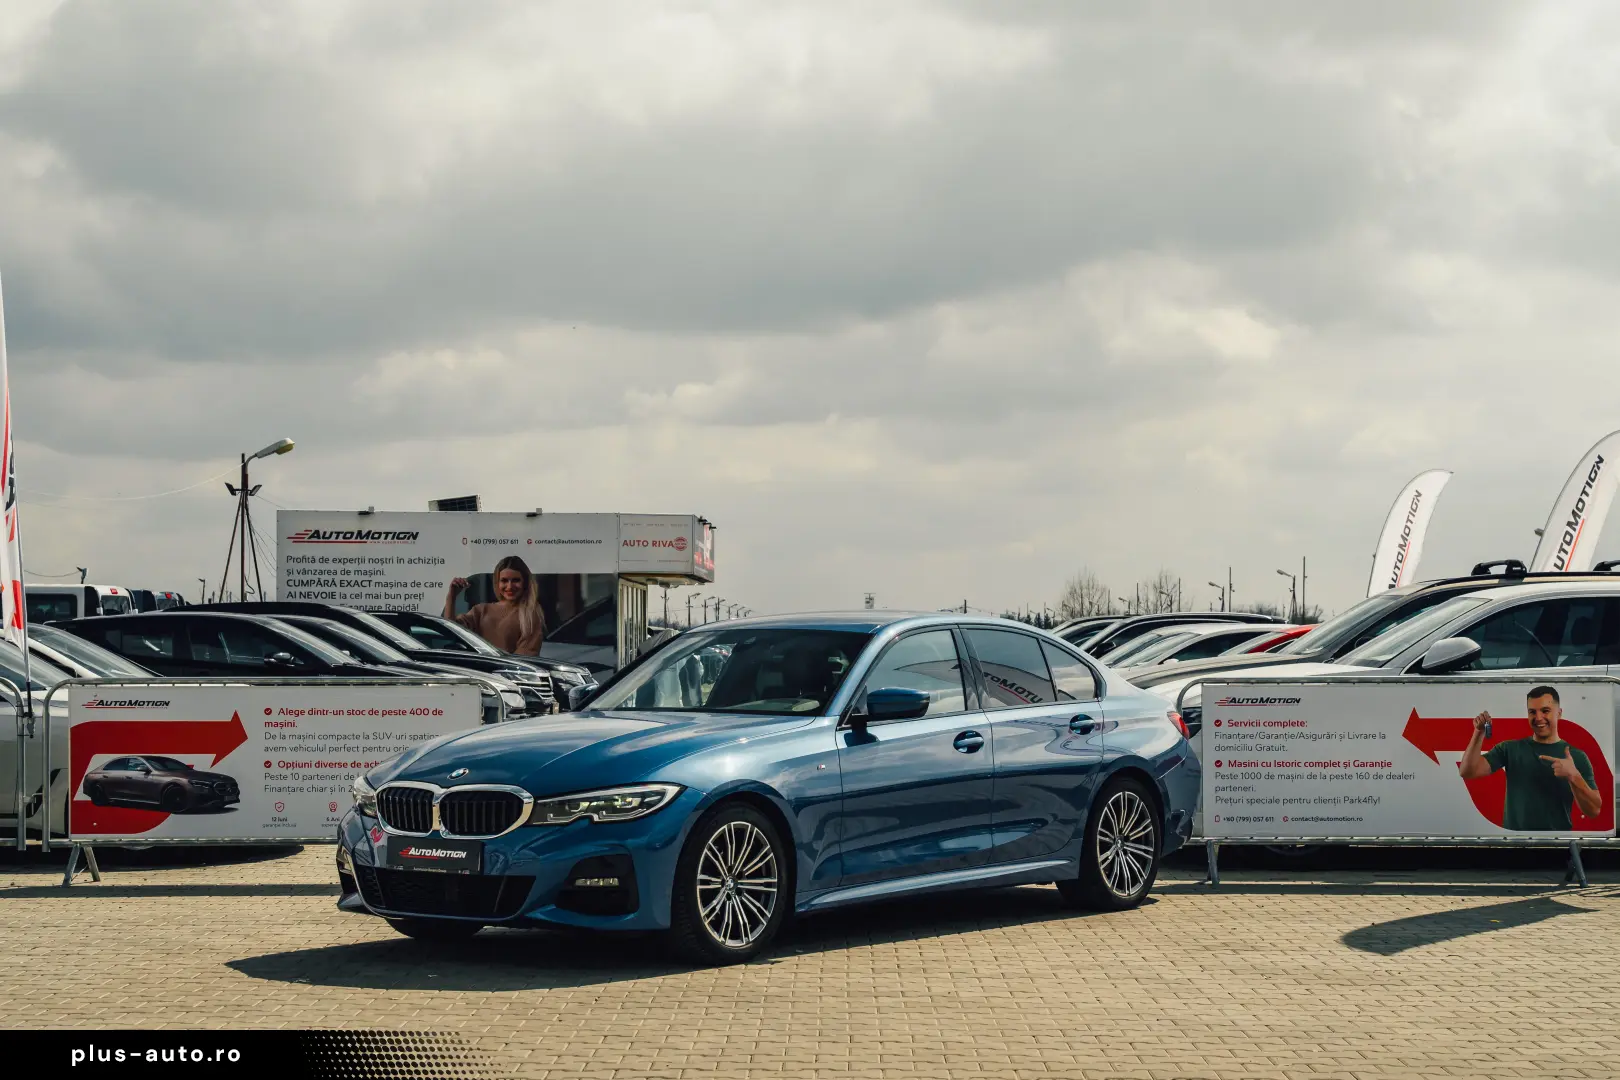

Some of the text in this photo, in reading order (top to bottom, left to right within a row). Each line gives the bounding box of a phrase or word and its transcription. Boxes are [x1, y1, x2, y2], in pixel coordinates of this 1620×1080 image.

[1553, 453, 1605, 572] UTOMOTION
[307, 529, 420, 541] AUTOMOTION
[622, 539, 649, 548] AUTO
[652, 540, 674, 548] RIVA
[286, 555, 446, 567] Profită de experții noștri în achiziția
[286, 567, 386, 578] și vânzarea de mașini.
[286, 577, 338, 588] CUMPĂRĂ
[339, 579, 373, 588] EXACT
[374, 580, 408, 590] mașina
[410, 580, 422, 588] de
[286, 591, 425, 602] AI NEVOIE la cel mai bun preț!
[95, 699, 171, 707] AUTOMOTION
[1228, 696, 1302, 704] AUTOMOTION
[278, 707, 444, 718] Alege dintr-un stoc de peste 400 de
[264, 719, 298, 729] mașini.
[1227, 719, 1308, 729] Servicii complete:
[264, 731, 277, 740] De
[279, 731, 287, 740] la
[288, 732, 316, 742] mașini
[317, 733, 361, 742] compacte
[362, 731, 370, 740] la
[372, 732, 407, 740] SUV-uri
[1214, 731, 1386, 742] Finanțare/Garanție/Asigurări și Livrare la
[264, 743, 410, 754] avem vehiculul perfect pentru oric
[1214, 743, 1288, 752] domiciliu Gratuit.
[277, 760, 313, 770] Opțiuni
[314, 760, 349, 768] diverse
[350, 760, 363, 768] de
[1228, 760, 1259, 768] Masini
[1273, 760, 1301, 768] Istoric
[1303, 760, 1341, 770] complet
[1342, 760, 1351, 770] și
[1352, 760, 1392, 770] Garanție
[264, 772, 289, 781] Peste
[290, 772, 300, 781] 10
[302, 772, 342, 783] parteneri
[343, 772, 355, 781] de
[1215, 772, 1415, 783] Peste 1000 de mașini de la peste 160 de dealeri
[264, 784, 354, 795] Finanțare chiar și în 2
[1214, 783, 1257, 794] parteneri.
[1215, 795, 1381, 806] Prețuri speciale pentru clienții Park4fly!
[408, 847, 467, 859] AUTOMOTION
